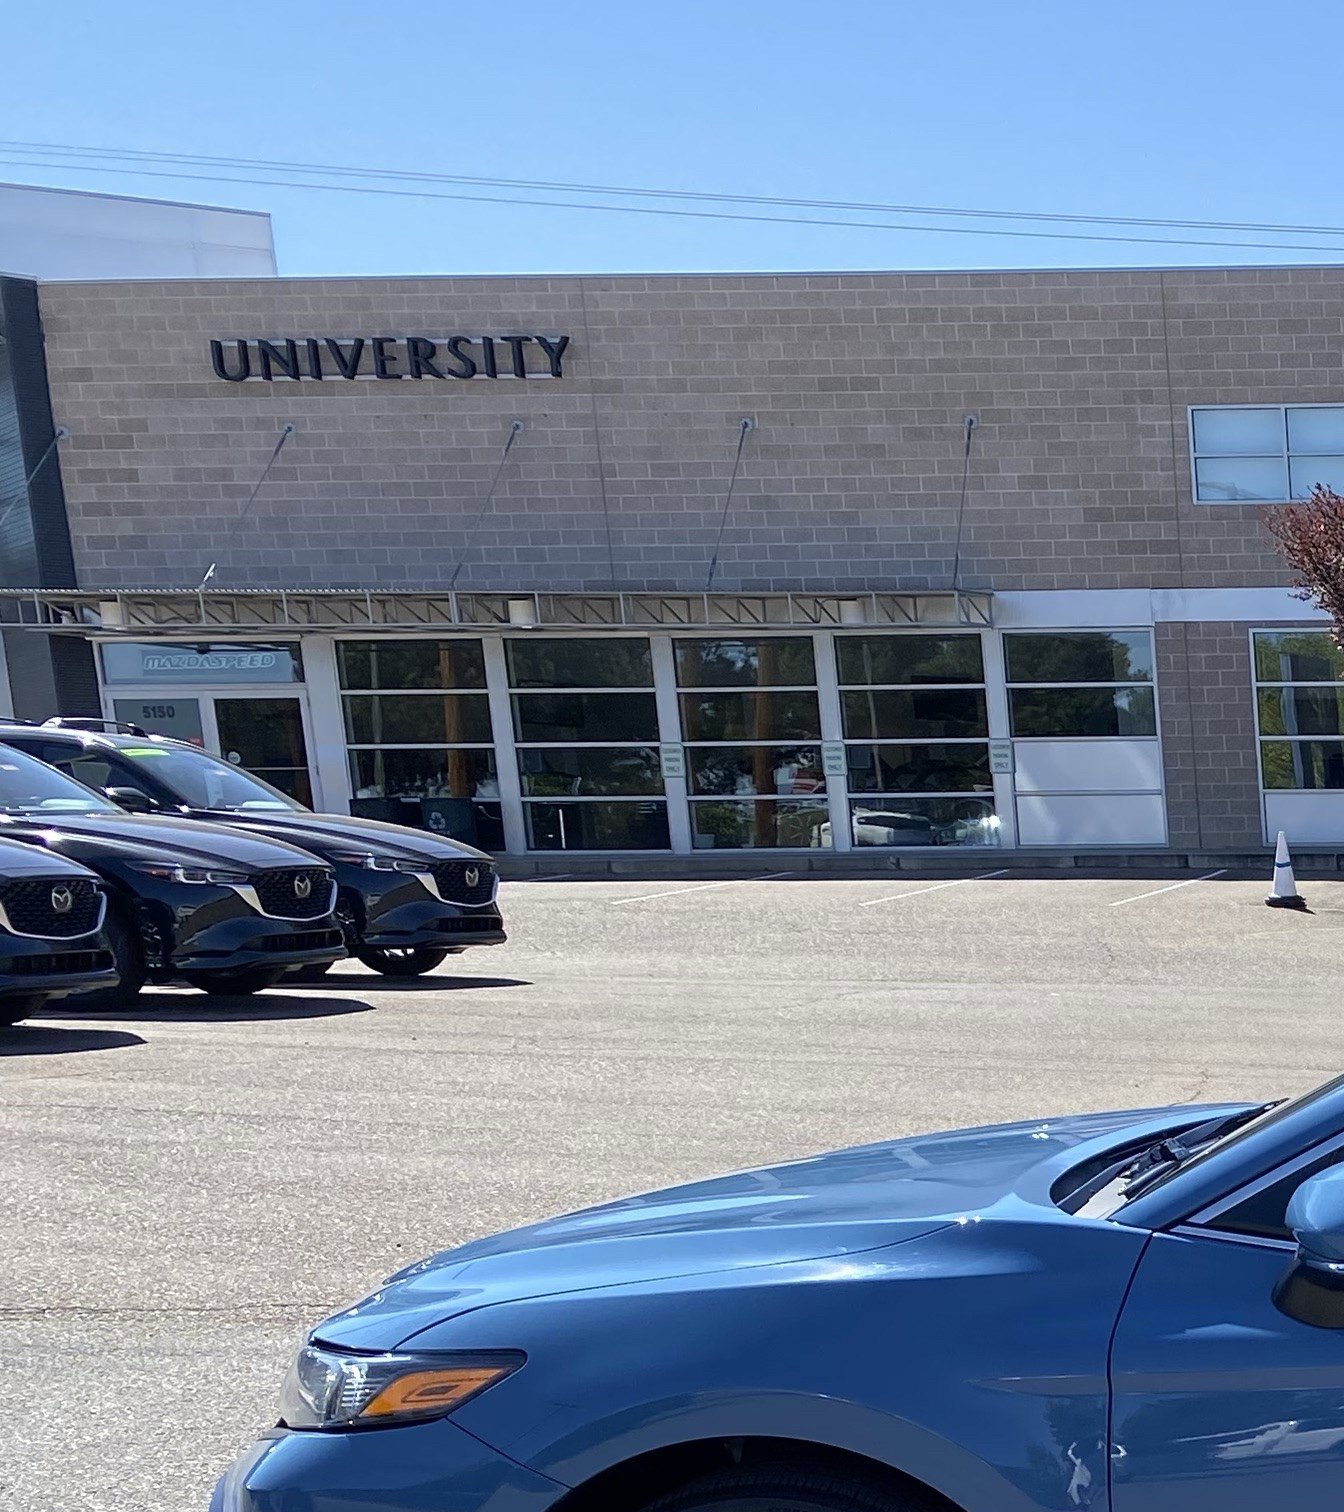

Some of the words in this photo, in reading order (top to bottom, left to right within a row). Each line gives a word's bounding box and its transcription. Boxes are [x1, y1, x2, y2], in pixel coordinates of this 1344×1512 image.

[210, 335, 570, 381] UNIVERSITY
[144, 653, 276, 670] MAZDASPEED
[142, 705, 175, 718] 5150
